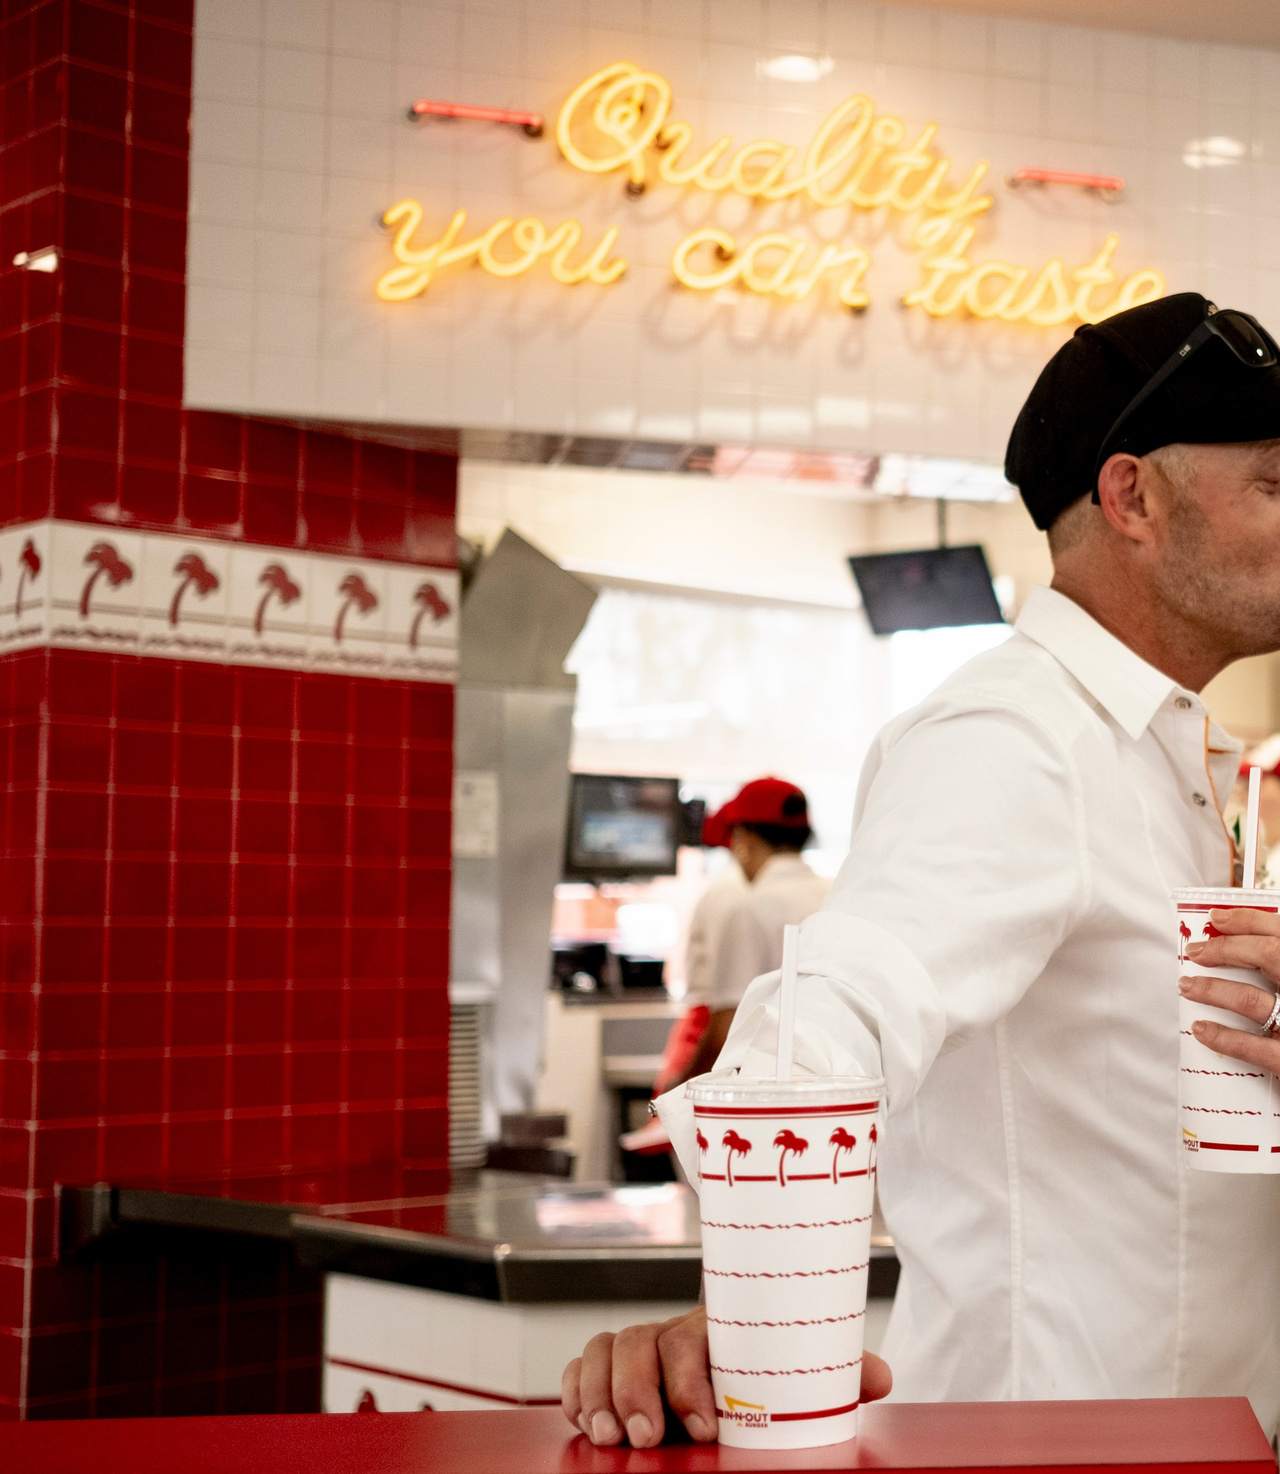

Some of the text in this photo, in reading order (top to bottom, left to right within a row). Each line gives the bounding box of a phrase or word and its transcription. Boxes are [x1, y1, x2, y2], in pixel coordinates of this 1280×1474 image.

[557, 62, 993, 248] Quality
[376, 199, 1166, 326] you can taste
[725, 1411, 768, 1422] IN-N-OUT
